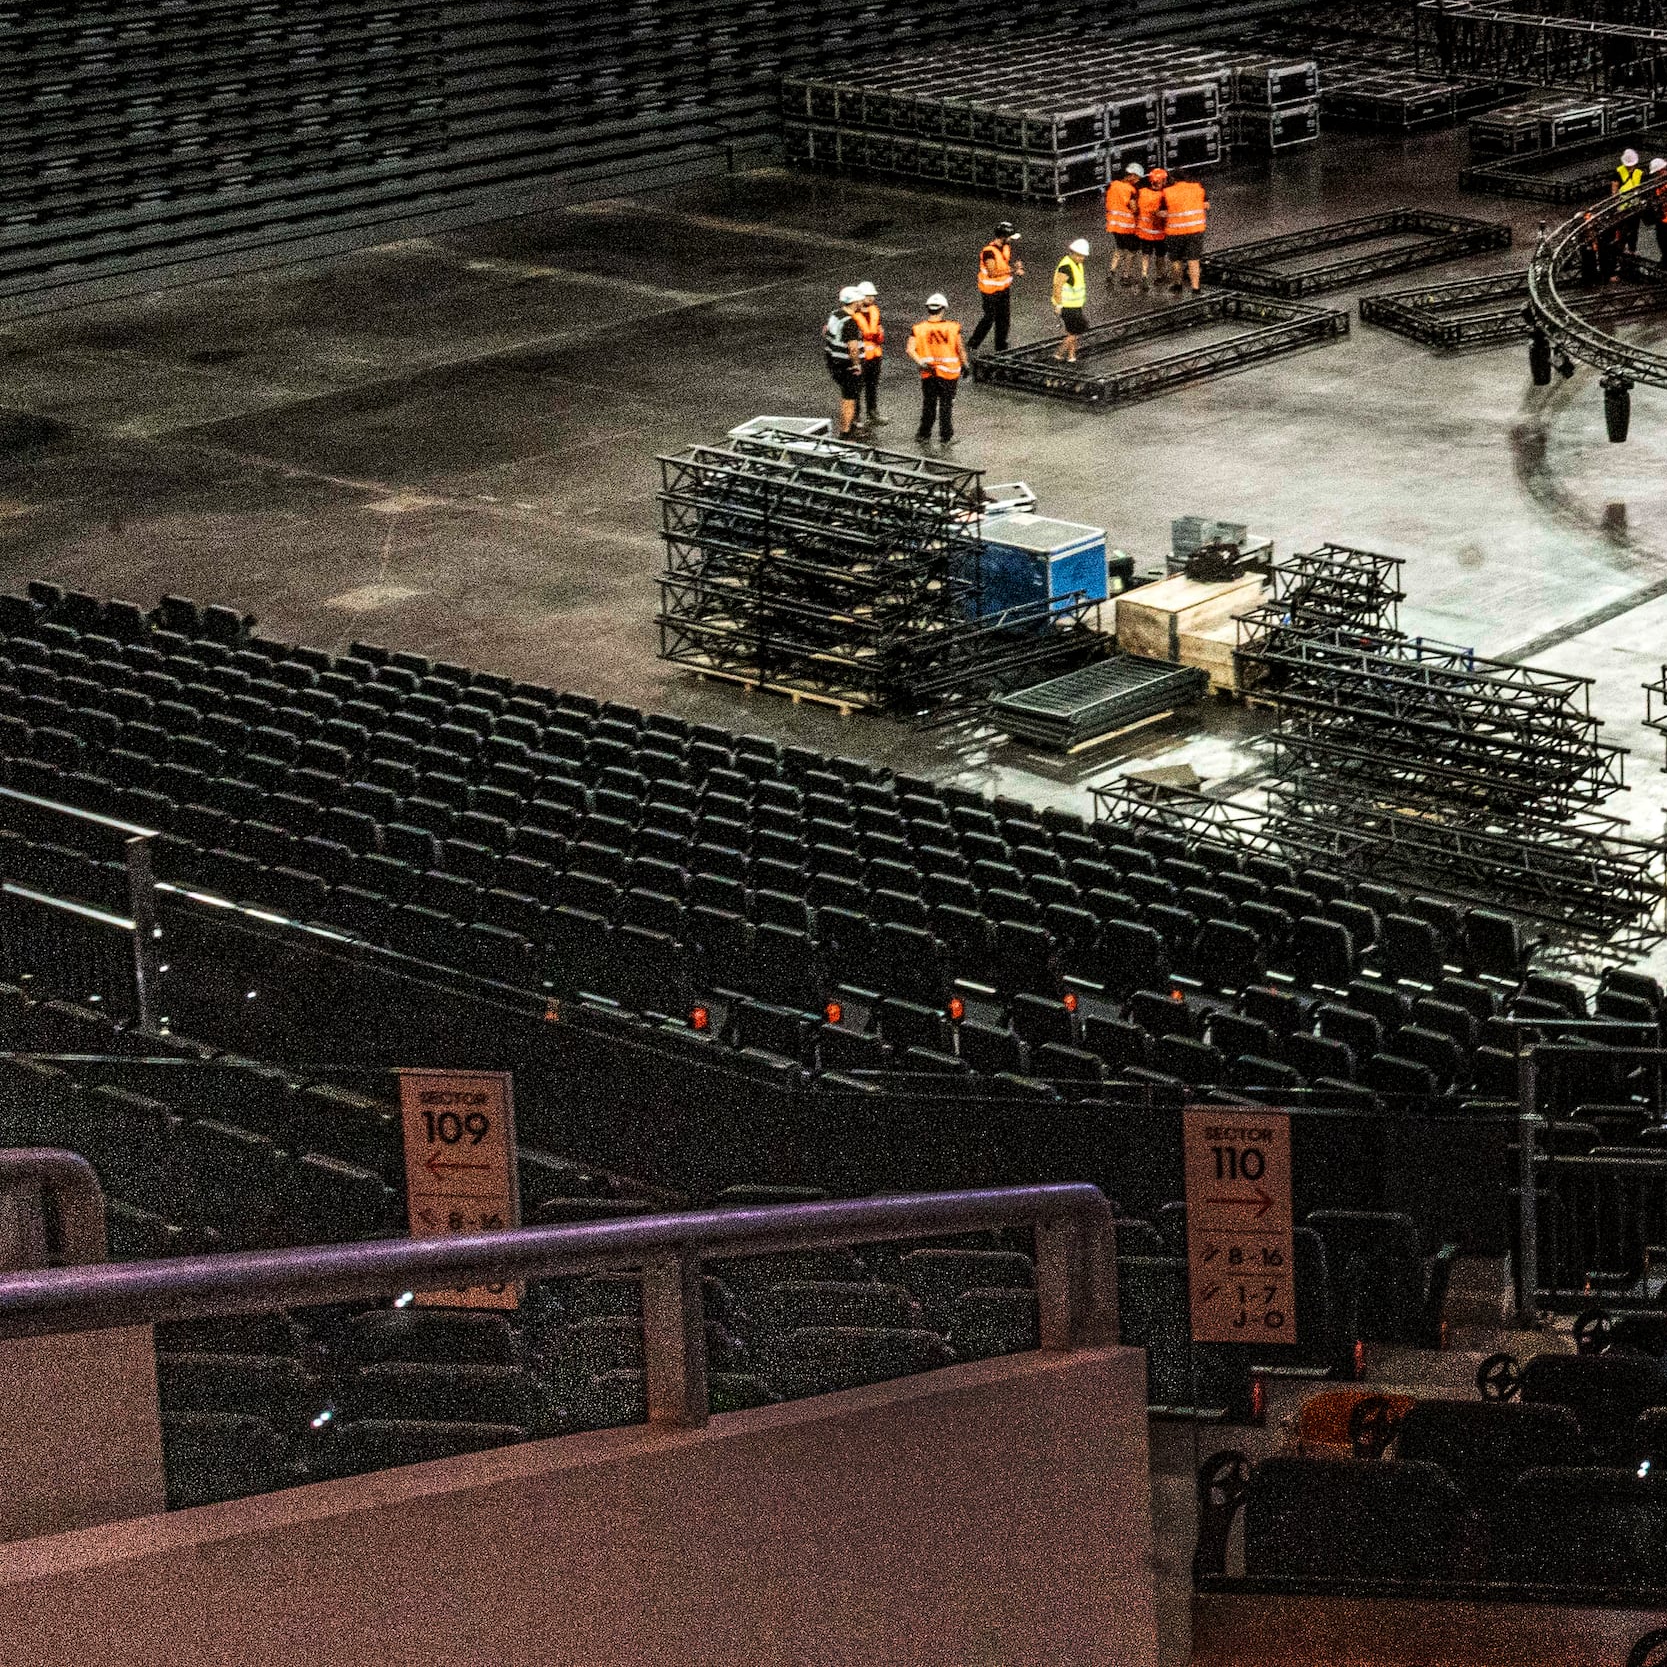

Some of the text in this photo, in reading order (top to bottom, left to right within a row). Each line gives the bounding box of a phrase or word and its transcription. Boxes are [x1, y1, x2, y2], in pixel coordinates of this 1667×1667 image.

[418, 1091, 489, 1106] SECTOR
[421, 1111, 490, 1146] 109
[1204, 1127, 1273, 1142] SECTOR
[1212, 1147, 1265, 1181] 110
